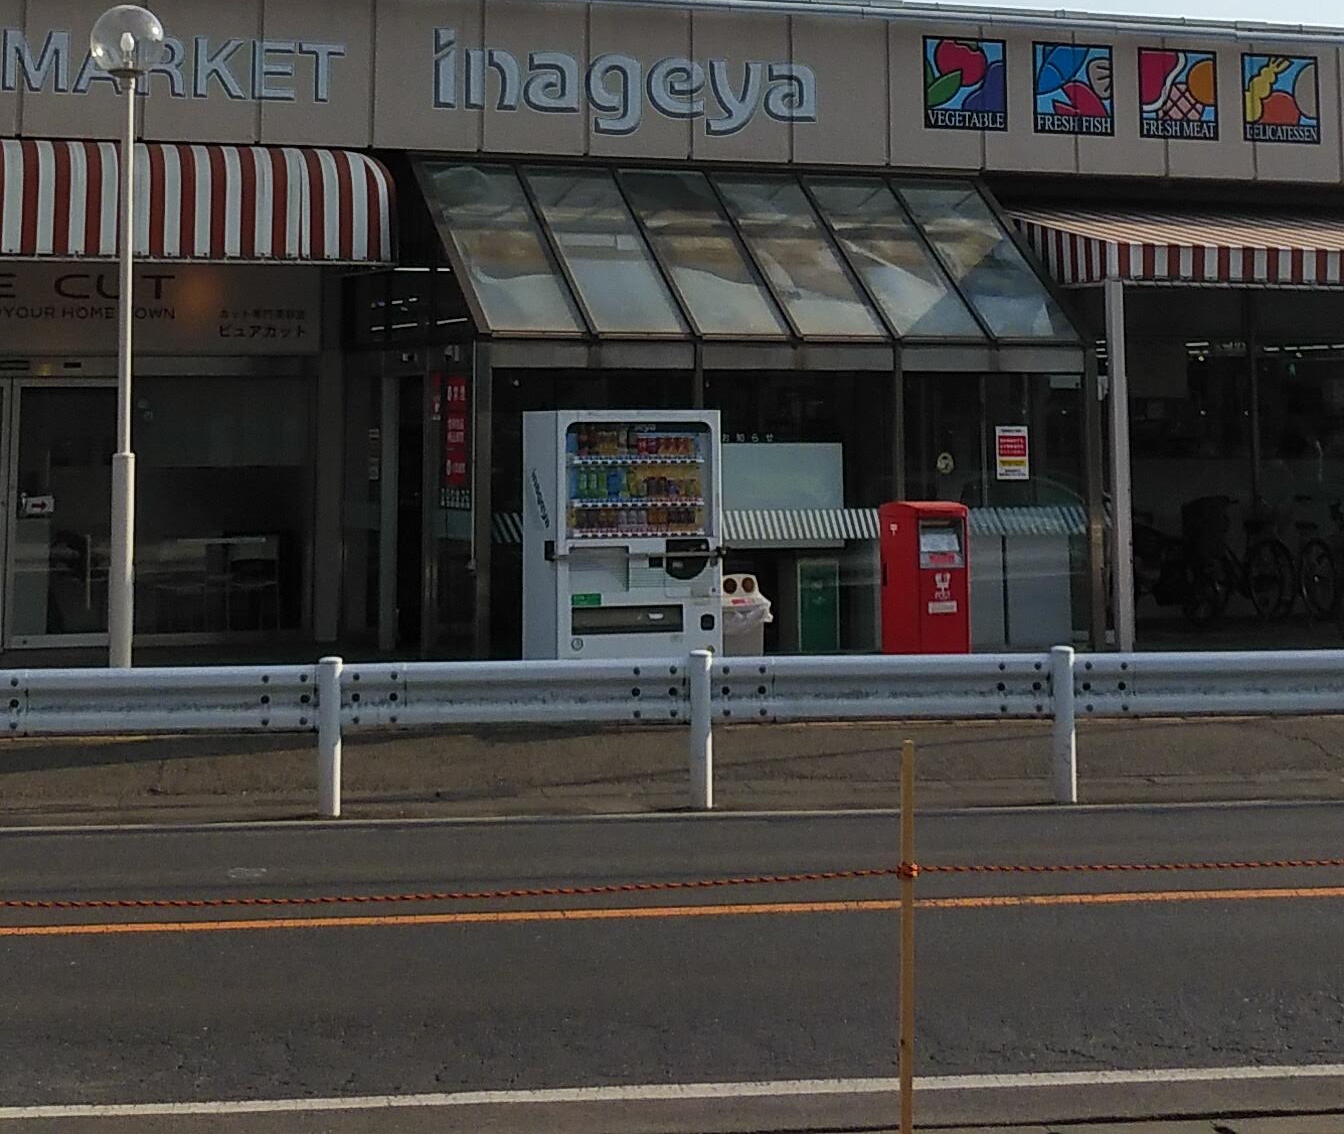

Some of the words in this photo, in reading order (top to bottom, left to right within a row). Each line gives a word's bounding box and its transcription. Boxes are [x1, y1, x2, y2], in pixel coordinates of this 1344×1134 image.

[1, 28, 346, 102] MARKET
[433, 28, 817, 136] inageya
[928, 109, 1005, 129] VEGETABLE
[1037, 113, 1078, 132] FRESH
[1082, 115, 1112, 134] FISH
[1143, 119, 1181, 137] FRESH
[1183, 121, 1216, 139] MEAT
[1246, 125, 1318, 143] DELICATESSEN
[54, 273, 176, 300] CUT
[126, 306, 176, 320] OWN
[218, 323, 305, 339] ピュアカット
[722, 433, 774, 443] お知らせ
